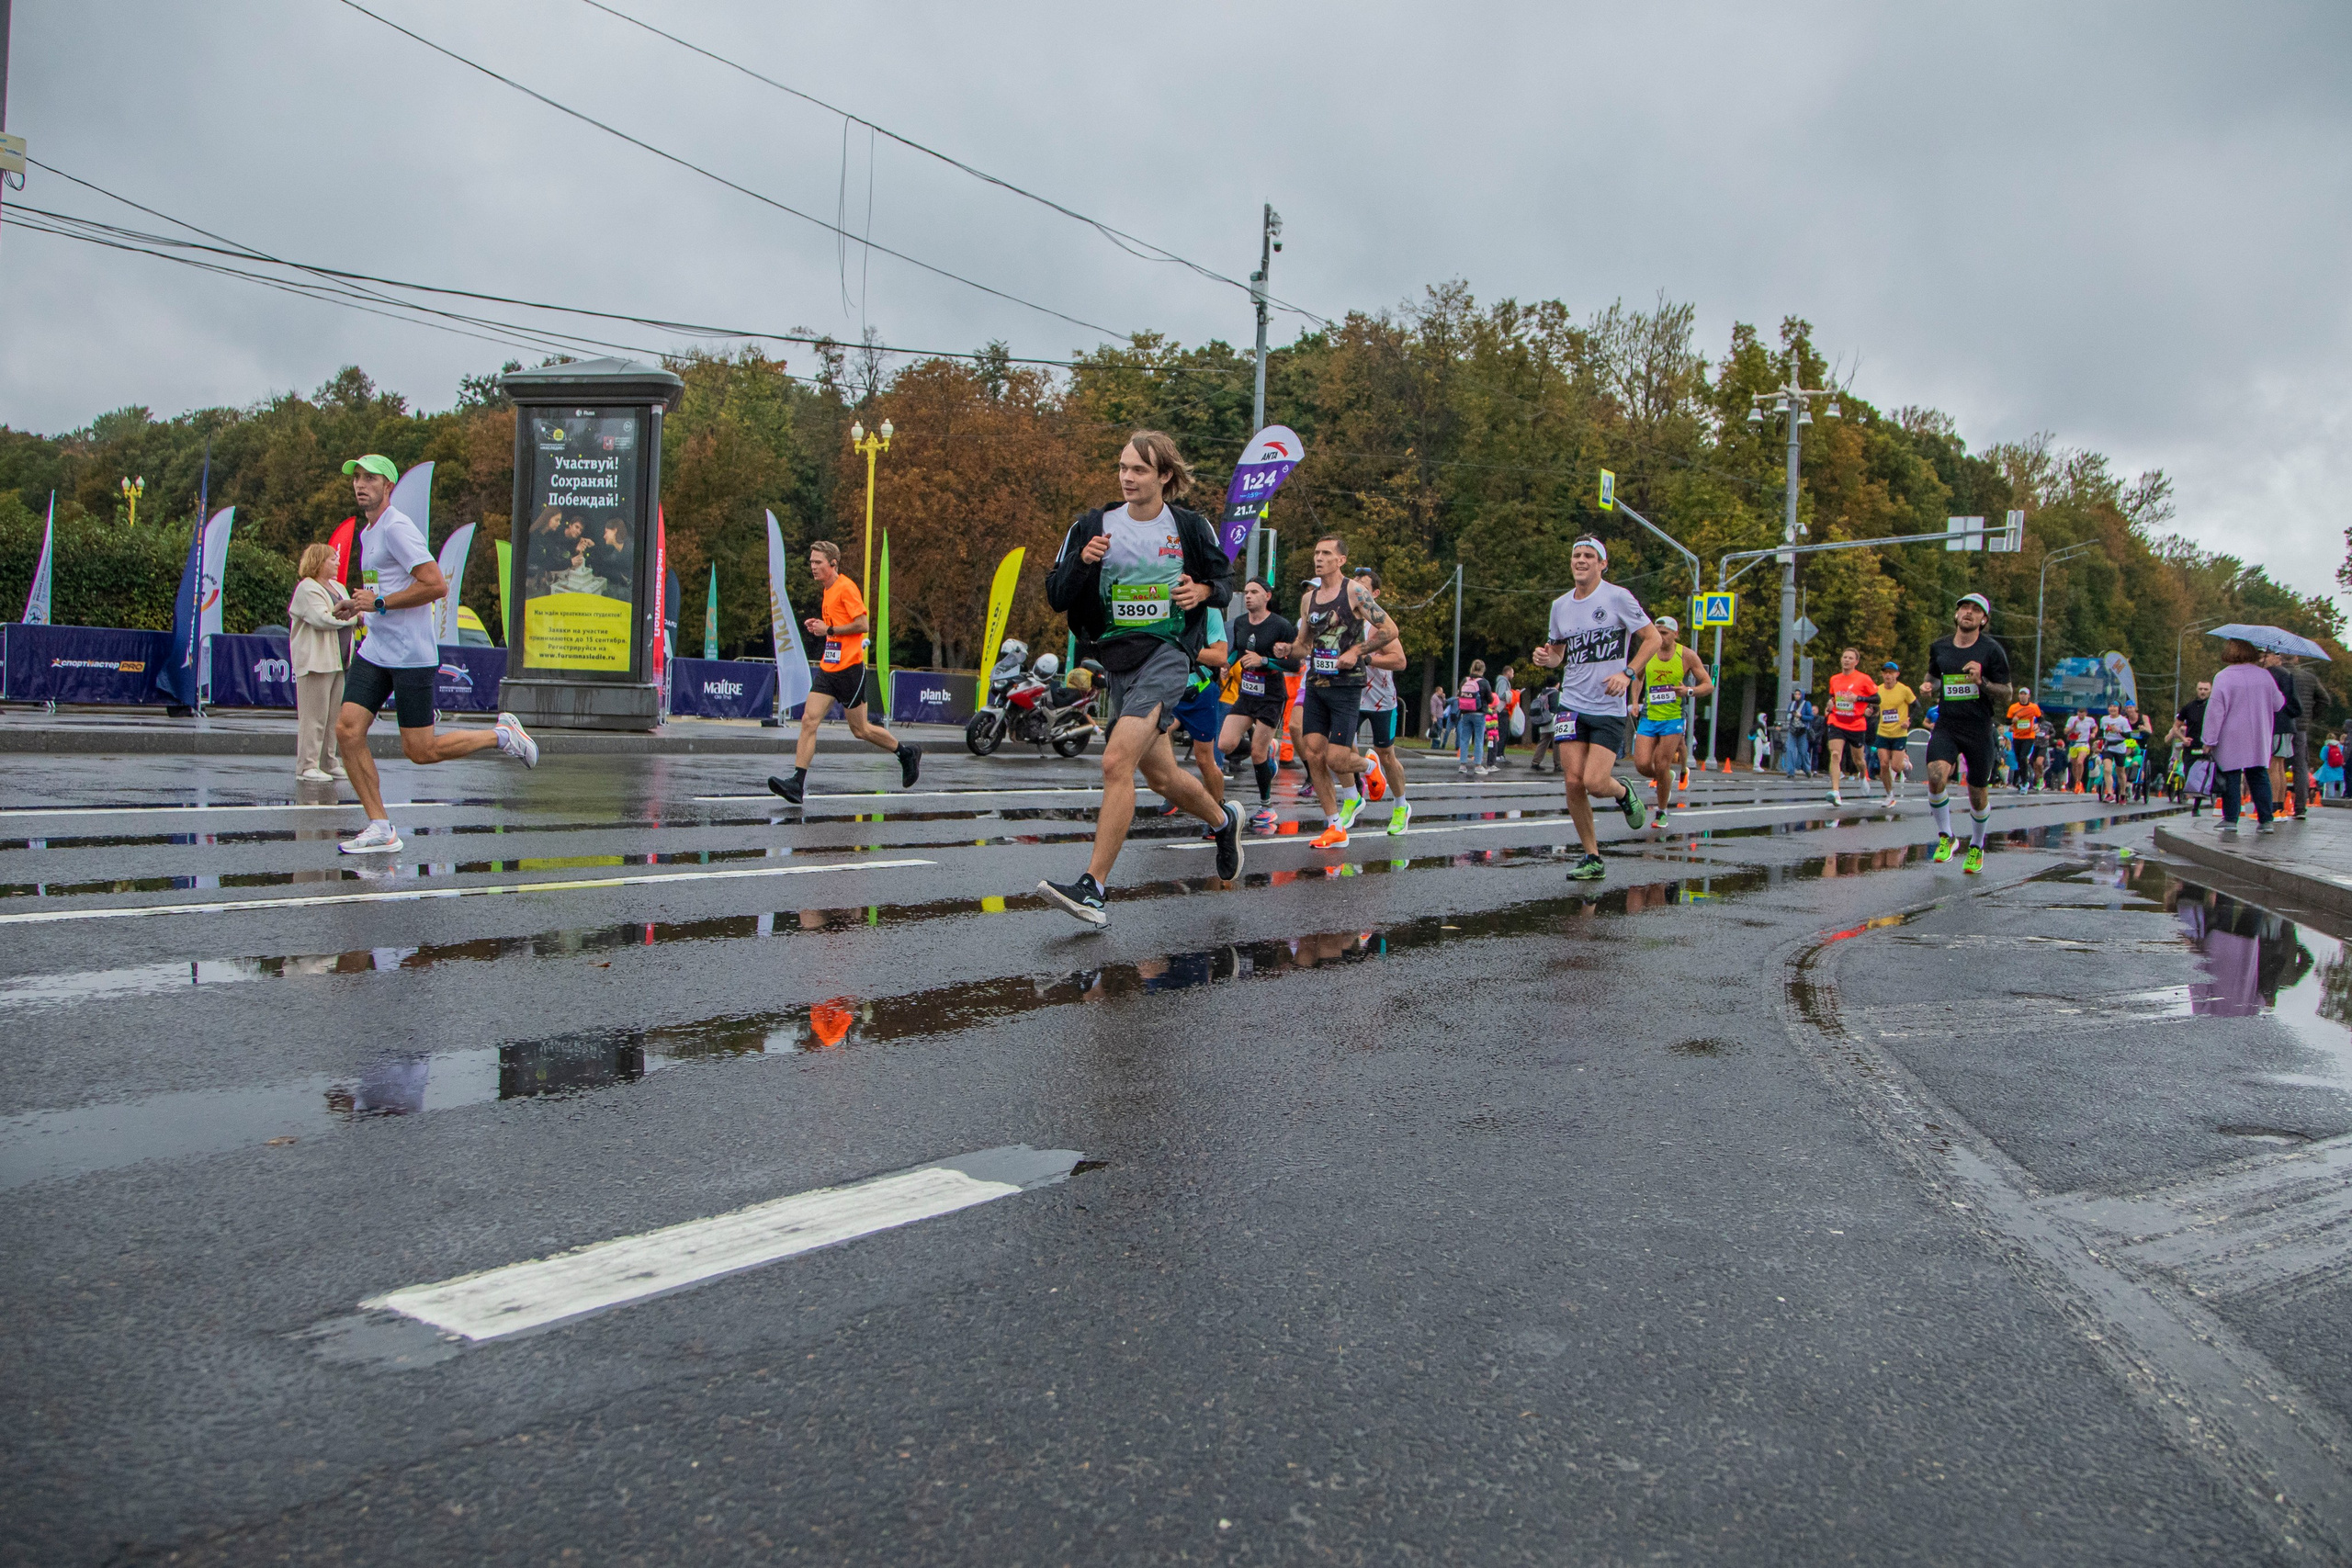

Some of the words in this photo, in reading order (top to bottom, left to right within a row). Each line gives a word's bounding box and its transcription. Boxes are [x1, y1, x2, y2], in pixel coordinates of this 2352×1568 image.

[1261, 451, 1278, 461] ANTA
[555, 456, 618, 473] Участвуй!
[551, 474, 618, 491] Сохраняй!
[1243, 470, 1277, 491] 1:24
[548, 492, 618, 508] Побеждай!
[1117, 604, 1158, 616] 3890
[1567, 626, 1614, 653] NEVER
[548, 644, 596, 652] Регистрируйся
[539, 652, 616, 660] www.forumnasledie.ru
[120, 662, 143, 671] PRO
[254, 659, 289, 682] 100
[1317, 660, 1335, 669] 5831
[921, 688, 942, 703] plan
[1947, 686, 1971, 694] 3988
